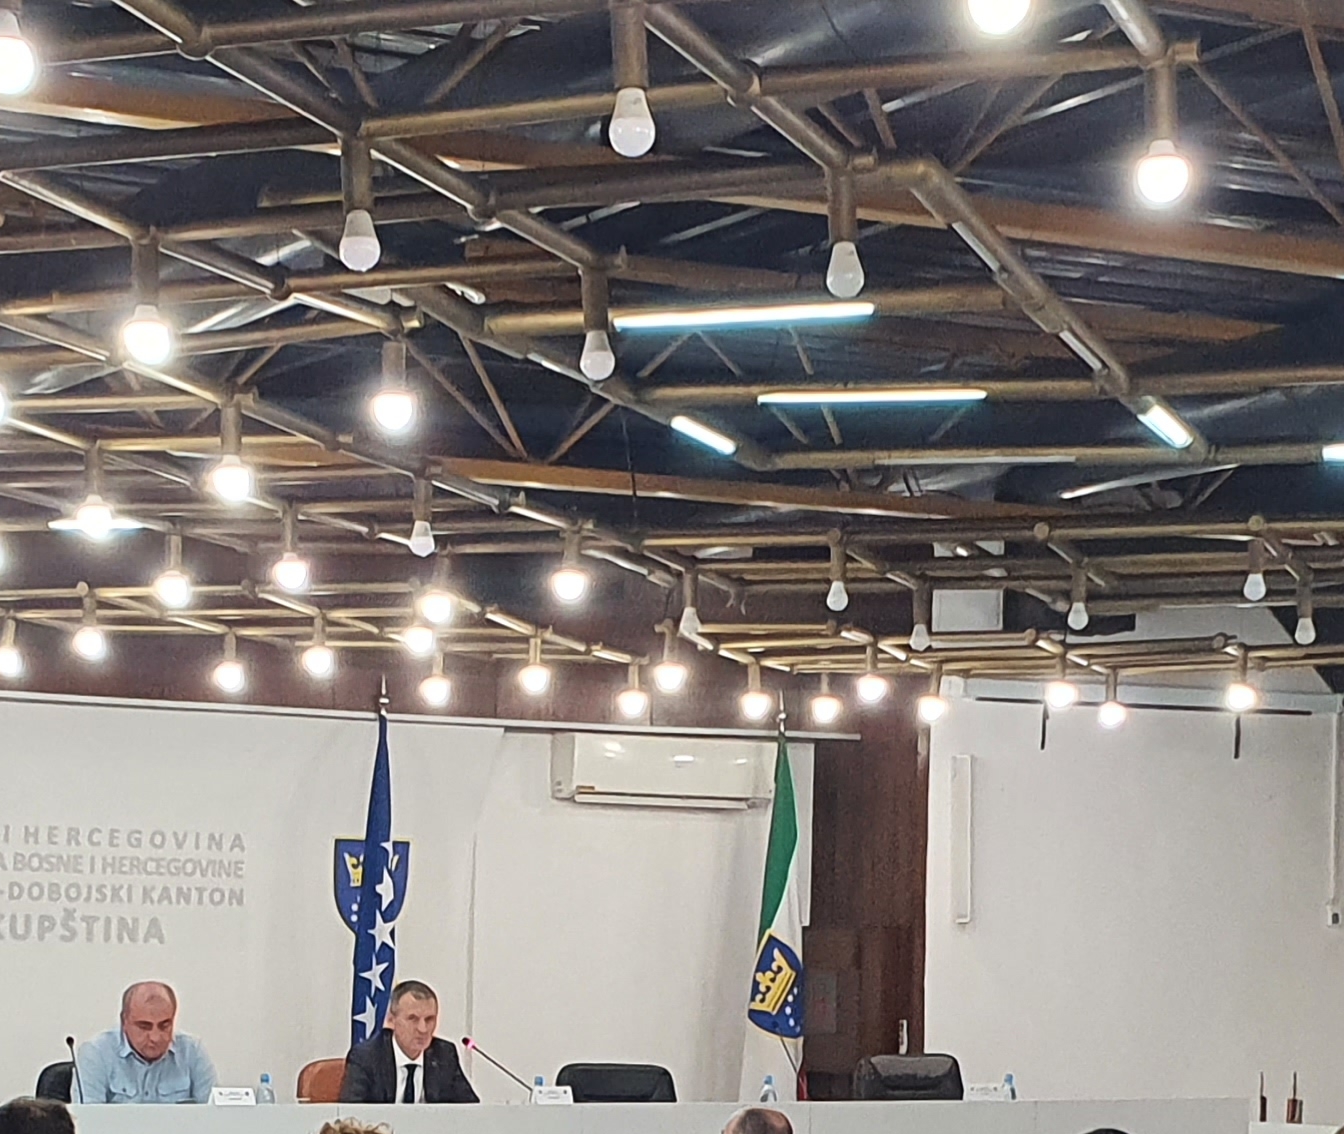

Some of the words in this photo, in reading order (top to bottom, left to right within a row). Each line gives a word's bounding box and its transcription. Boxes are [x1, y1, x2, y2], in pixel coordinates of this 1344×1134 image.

[3, 824, 10, 843] I
[24, 825, 246, 852] HERCEGOVINA
[12, 851, 83, 874] BOSNE
[89, 855, 96, 874] I
[101, 855, 245, 879] HERCEGOVINE
[142, 884, 244, 906] KANTON
